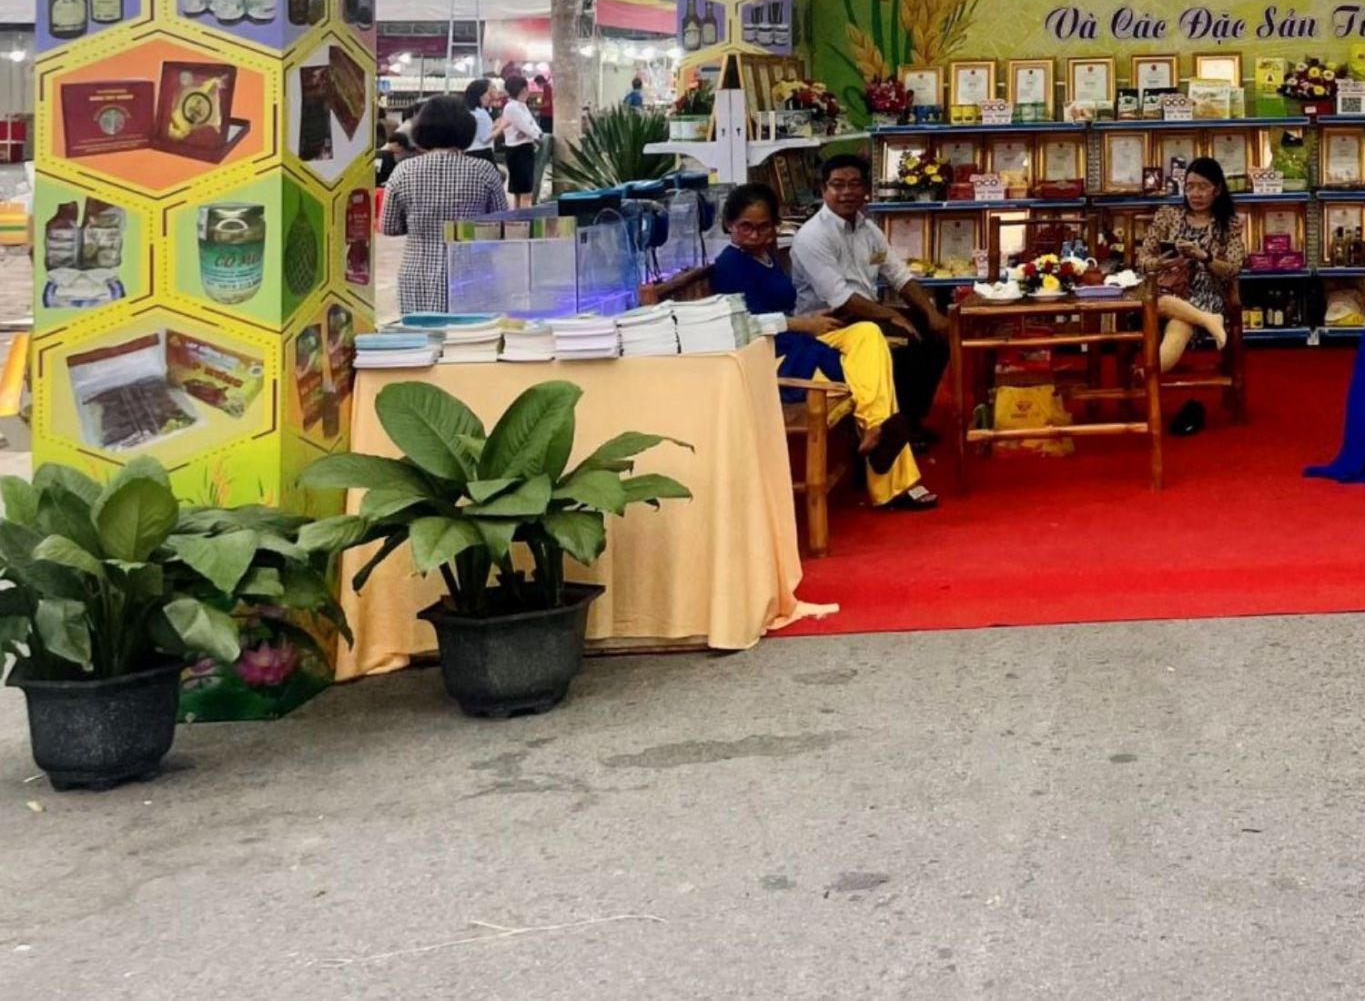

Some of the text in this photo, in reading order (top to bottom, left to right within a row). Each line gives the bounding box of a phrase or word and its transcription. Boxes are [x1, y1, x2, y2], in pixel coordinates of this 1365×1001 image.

[1044, 6, 1097, 39] Và
[1110, 6, 1167, 39] Các
[1178, 6, 1245, 45] Đặc
[1256, 5, 1316, 39] Sản
